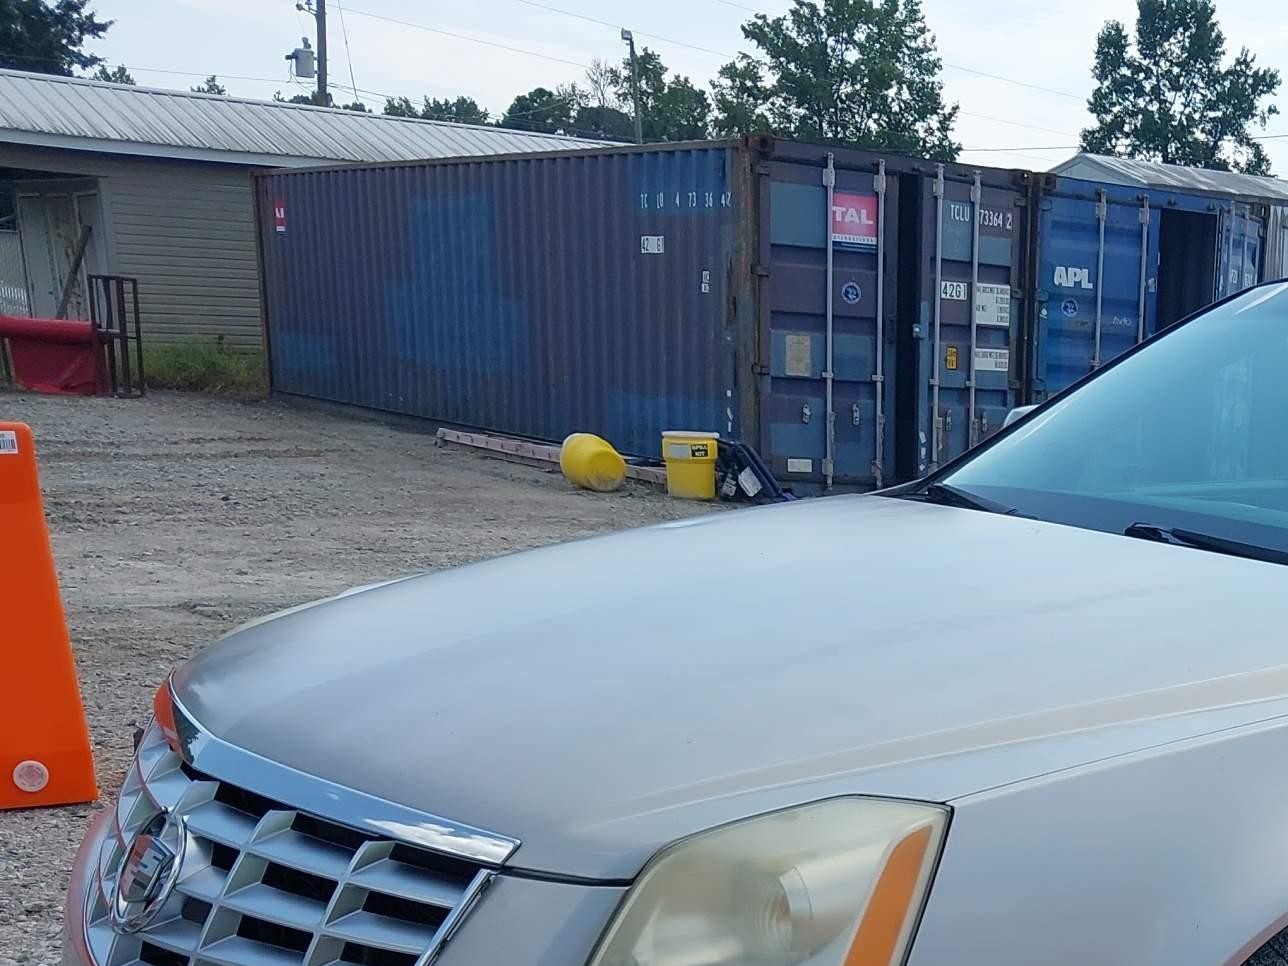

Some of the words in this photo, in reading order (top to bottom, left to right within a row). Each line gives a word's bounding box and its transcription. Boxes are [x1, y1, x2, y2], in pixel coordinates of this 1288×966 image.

[832, 206, 874, 225] TAL
[950, 203, 970, 222] TCLU
[1006, 212, 1013, 230] 2
[1053, 266, 1094, 289] APL
[942, 283, 967, 299] 42G1
